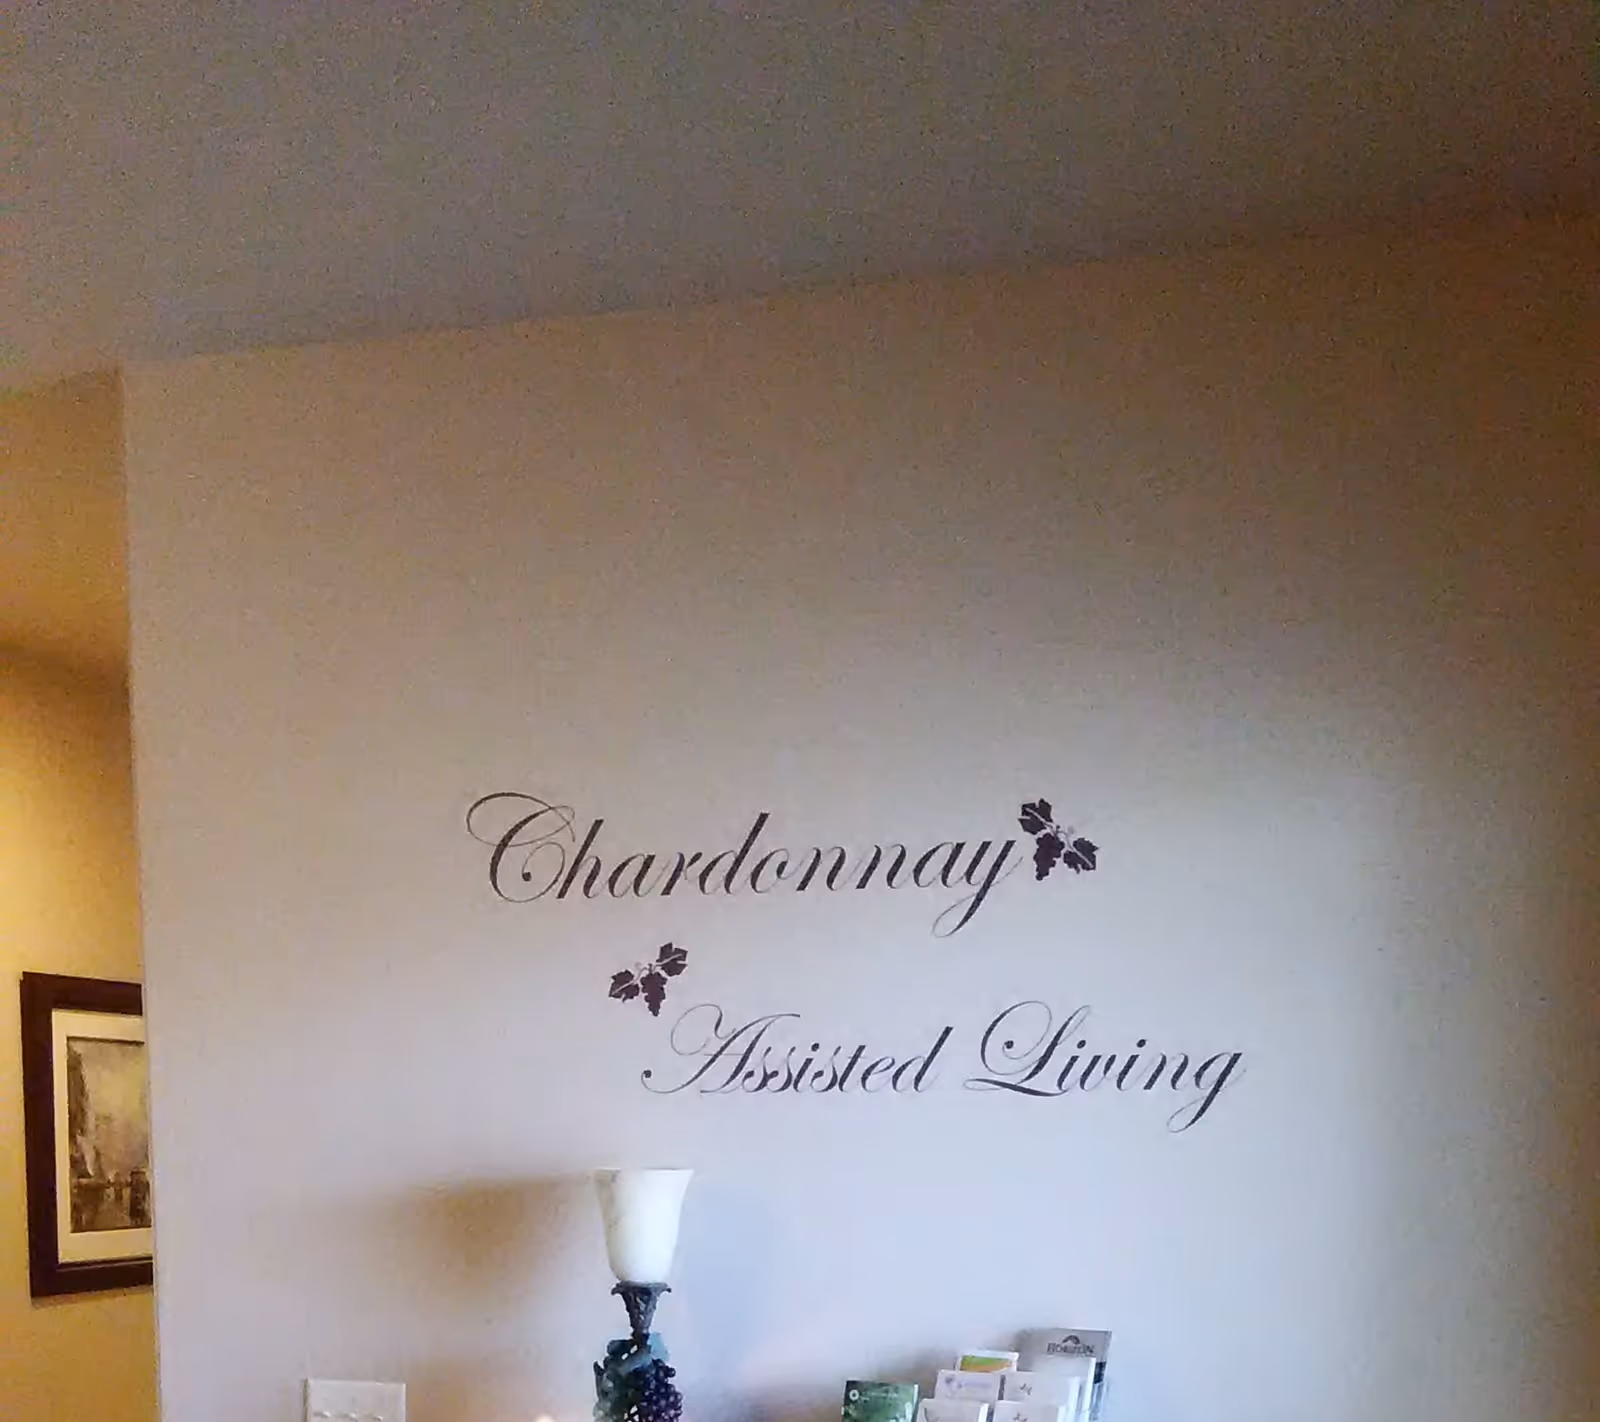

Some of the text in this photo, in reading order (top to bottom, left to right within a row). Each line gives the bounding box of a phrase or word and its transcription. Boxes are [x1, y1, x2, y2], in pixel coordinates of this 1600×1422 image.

[466, 792, 1022, 938] Chardonnay
[641, 1000, 1244, 1133] Assisted Living
